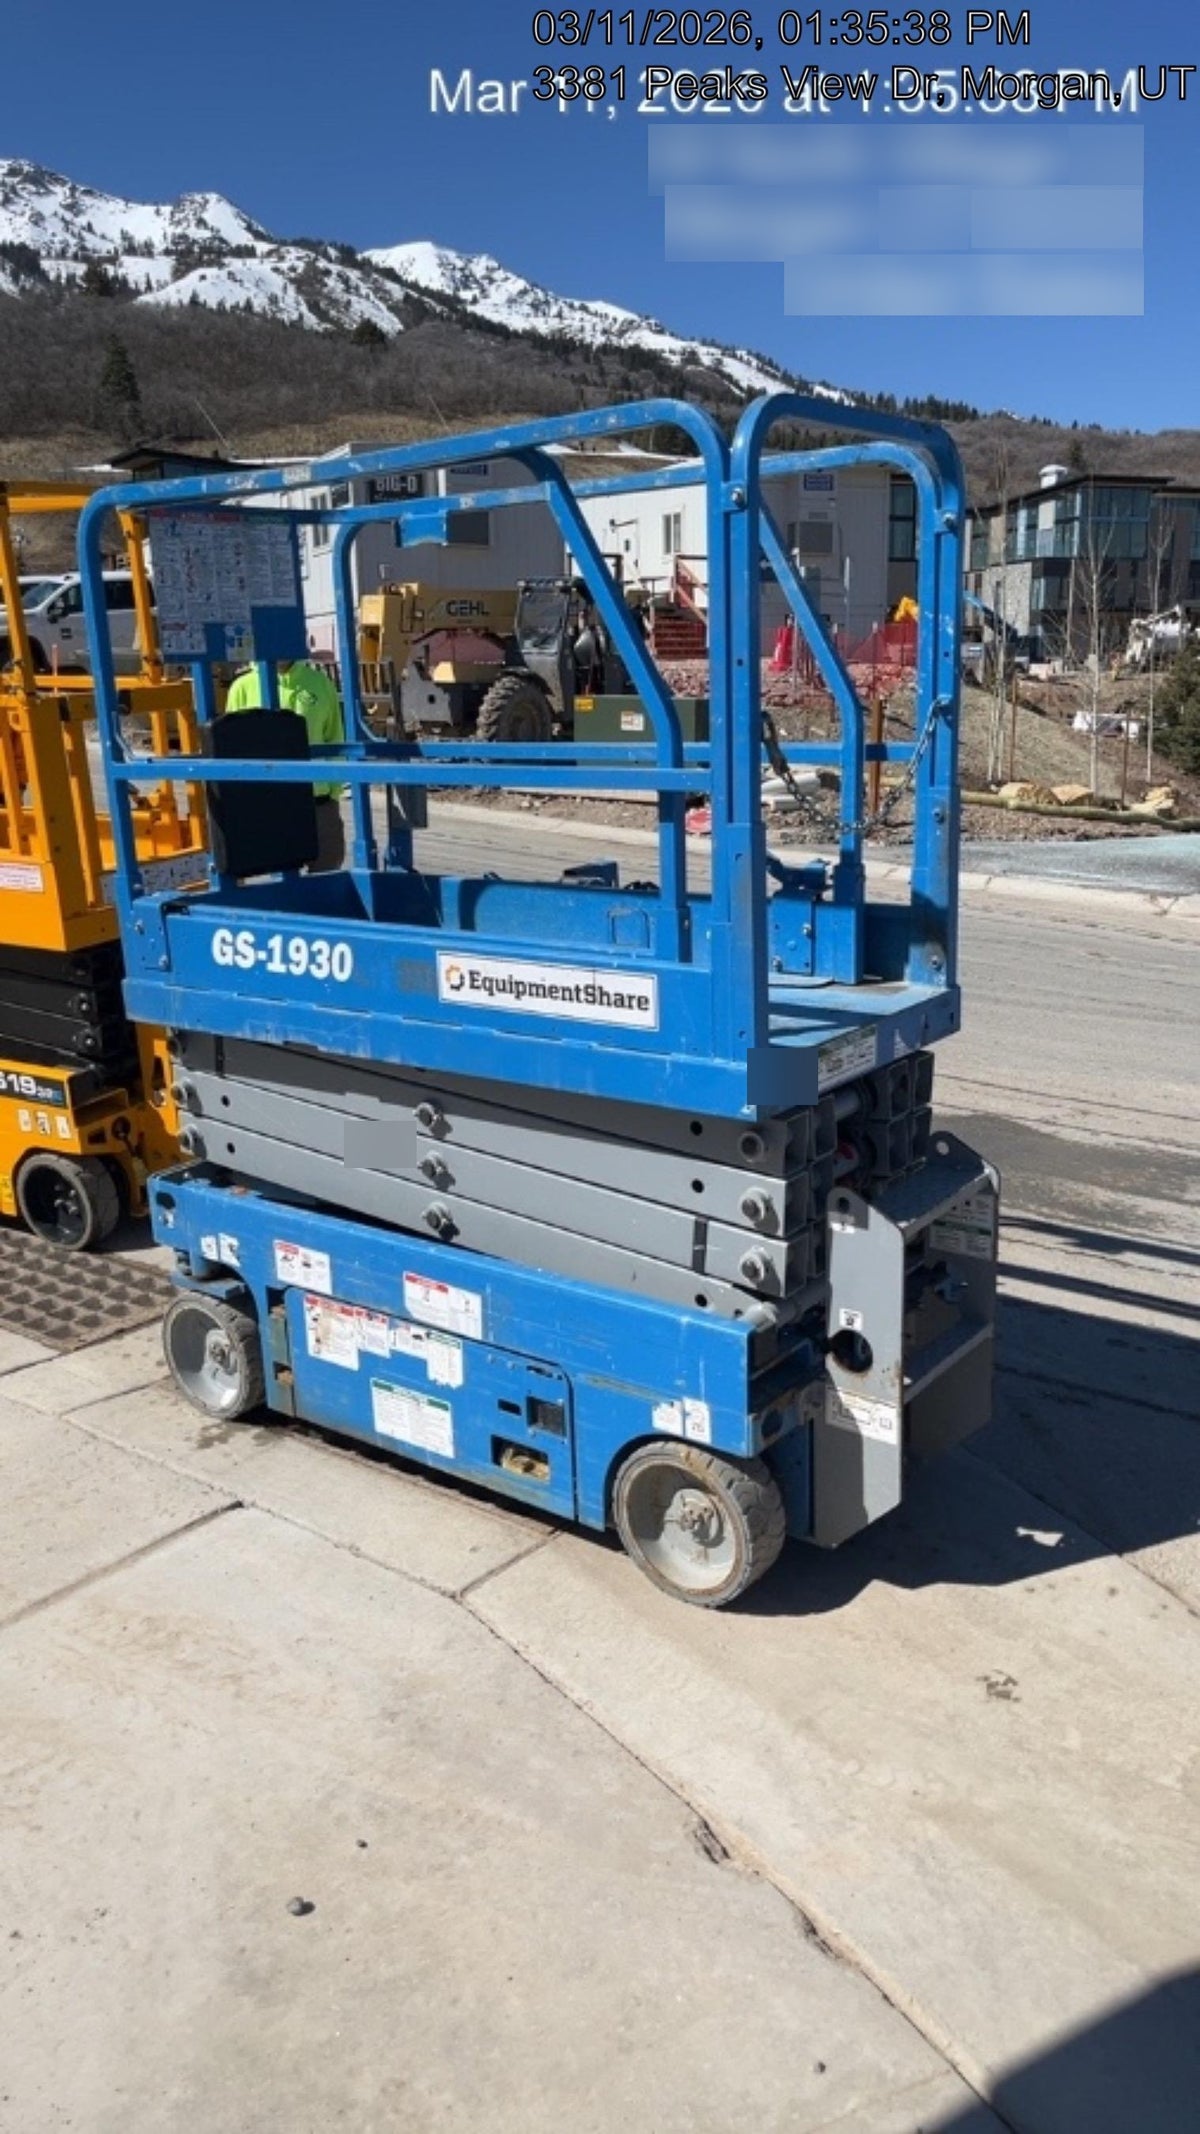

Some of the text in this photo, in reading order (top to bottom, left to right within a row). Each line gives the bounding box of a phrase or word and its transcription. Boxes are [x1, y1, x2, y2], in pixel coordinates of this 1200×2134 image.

[446, 600, 490, 616] GEHL
[212, 928, 353, 982] GS-1930
[468, 969, 650, 1011] EquipmentShare
